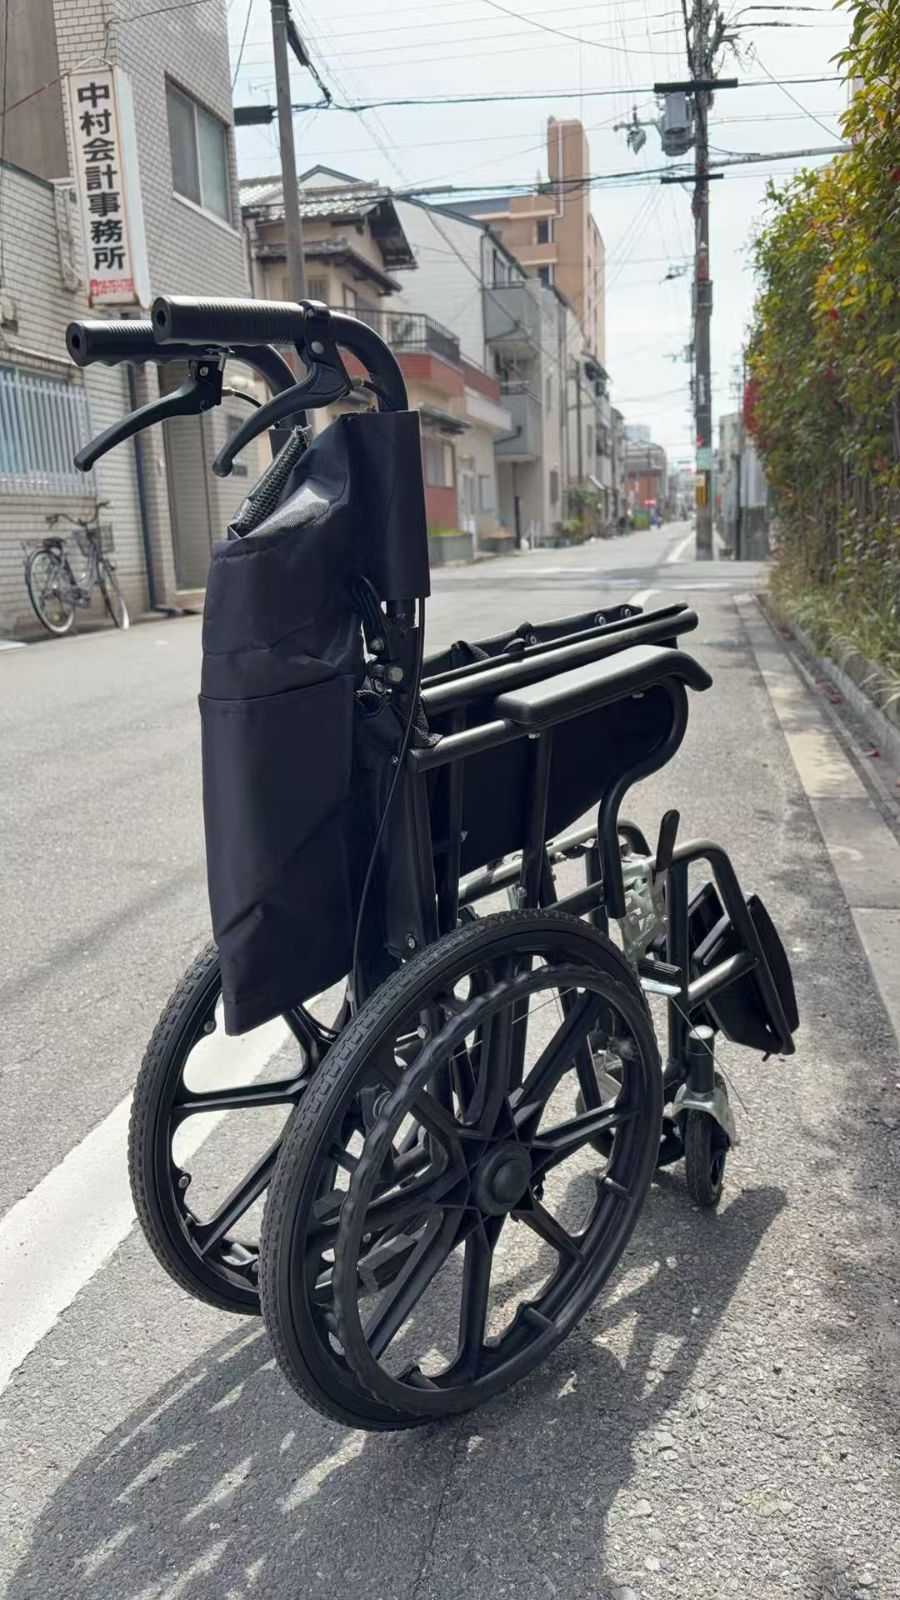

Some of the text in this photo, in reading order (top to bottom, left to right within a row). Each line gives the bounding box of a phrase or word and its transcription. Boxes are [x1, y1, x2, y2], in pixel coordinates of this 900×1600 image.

[77, 82, 125, 270] 中村会計事務所
